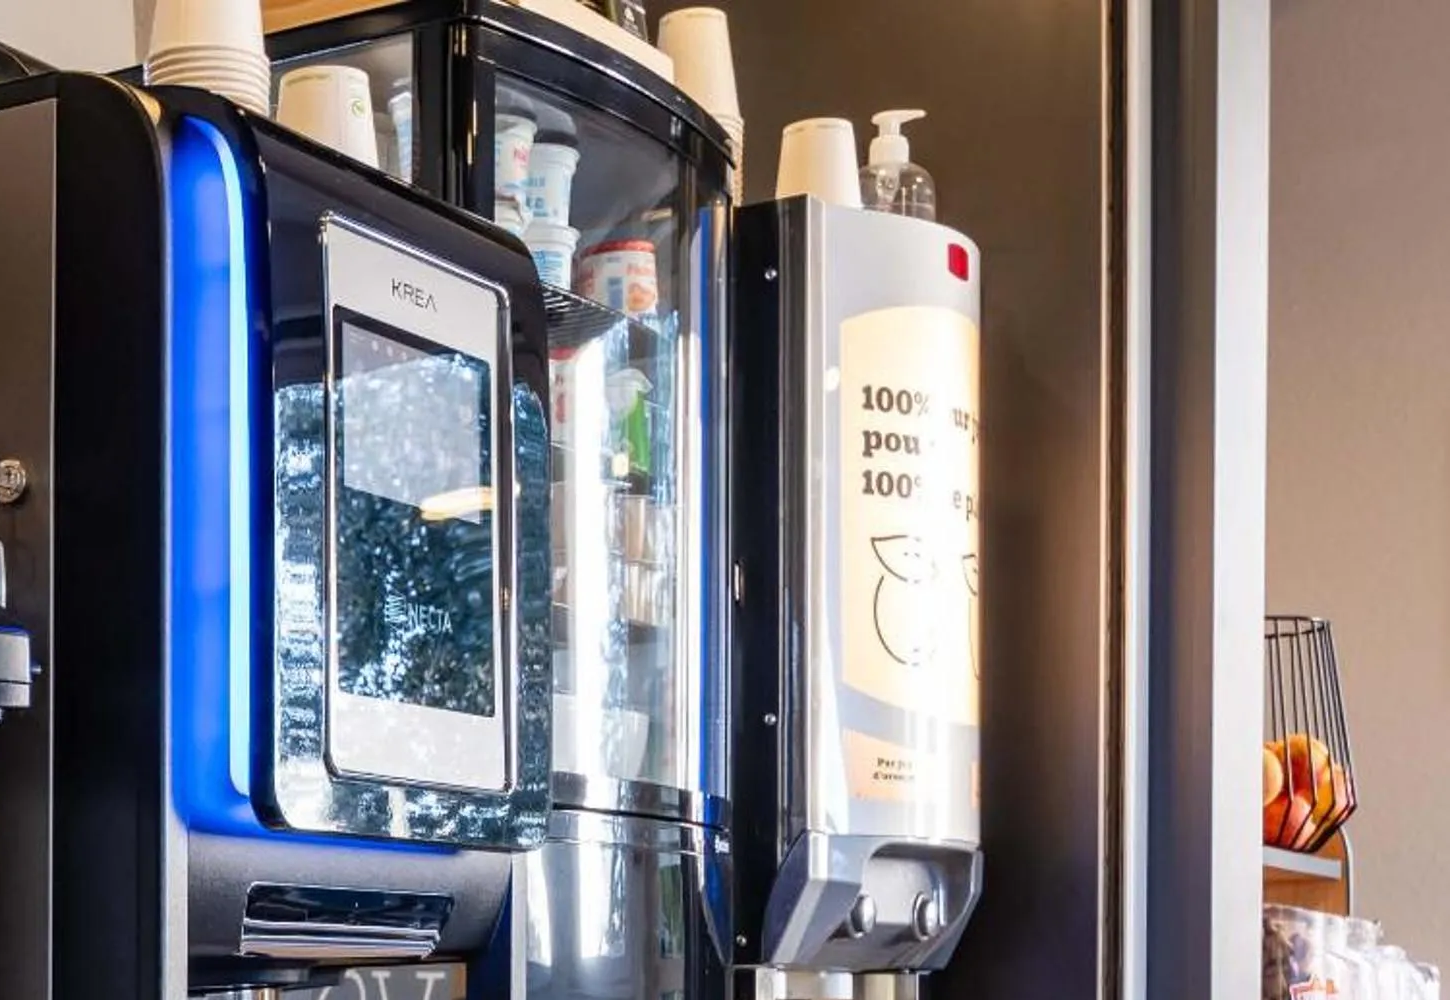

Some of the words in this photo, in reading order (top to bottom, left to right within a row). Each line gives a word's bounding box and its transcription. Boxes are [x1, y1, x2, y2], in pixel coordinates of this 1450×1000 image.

[861, 383, 931, 417] 100%
[861, 429, 926, 459] pou
[861, 468, 924, 499] 100
[407, 602, 454, 634] NECTA
